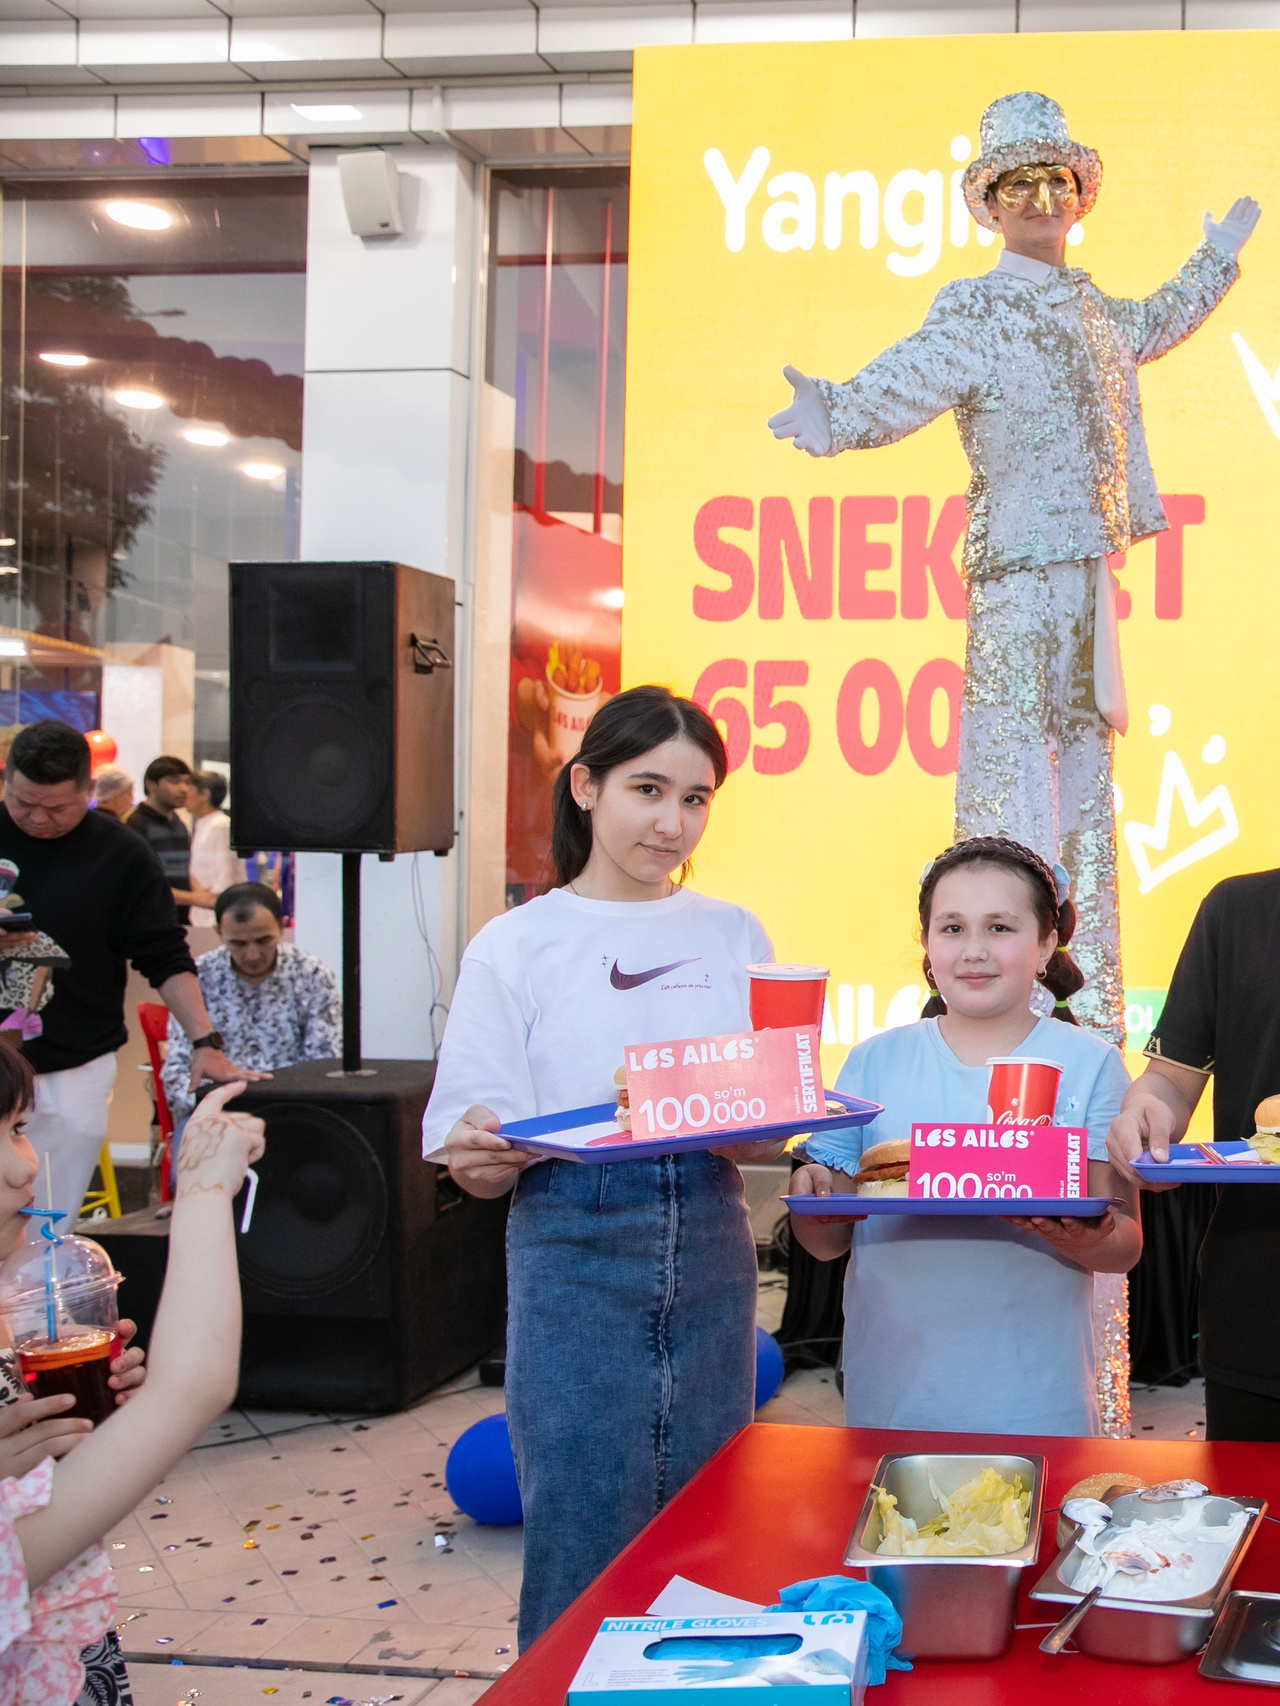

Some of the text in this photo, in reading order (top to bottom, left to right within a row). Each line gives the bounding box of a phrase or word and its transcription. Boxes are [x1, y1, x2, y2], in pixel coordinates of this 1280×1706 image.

[692, 494, 1206, 622] SNEKT
[692, 657, 966, 777] 65 00
[629, 1038, 755, 1072] LES AILES
[795, 1032, 818, 1114] SERTIFIKAT
[638, 1093, 766, 1133] 100 000
[914, 1128, 1029, 1149] LES AILES
[916, 1172, 1033, 1198] 100 000
[1066, 1132, 1081, 1198] ERTIFIKAT
[606, 1617, 768, 1632] NITRILE GLOVES
